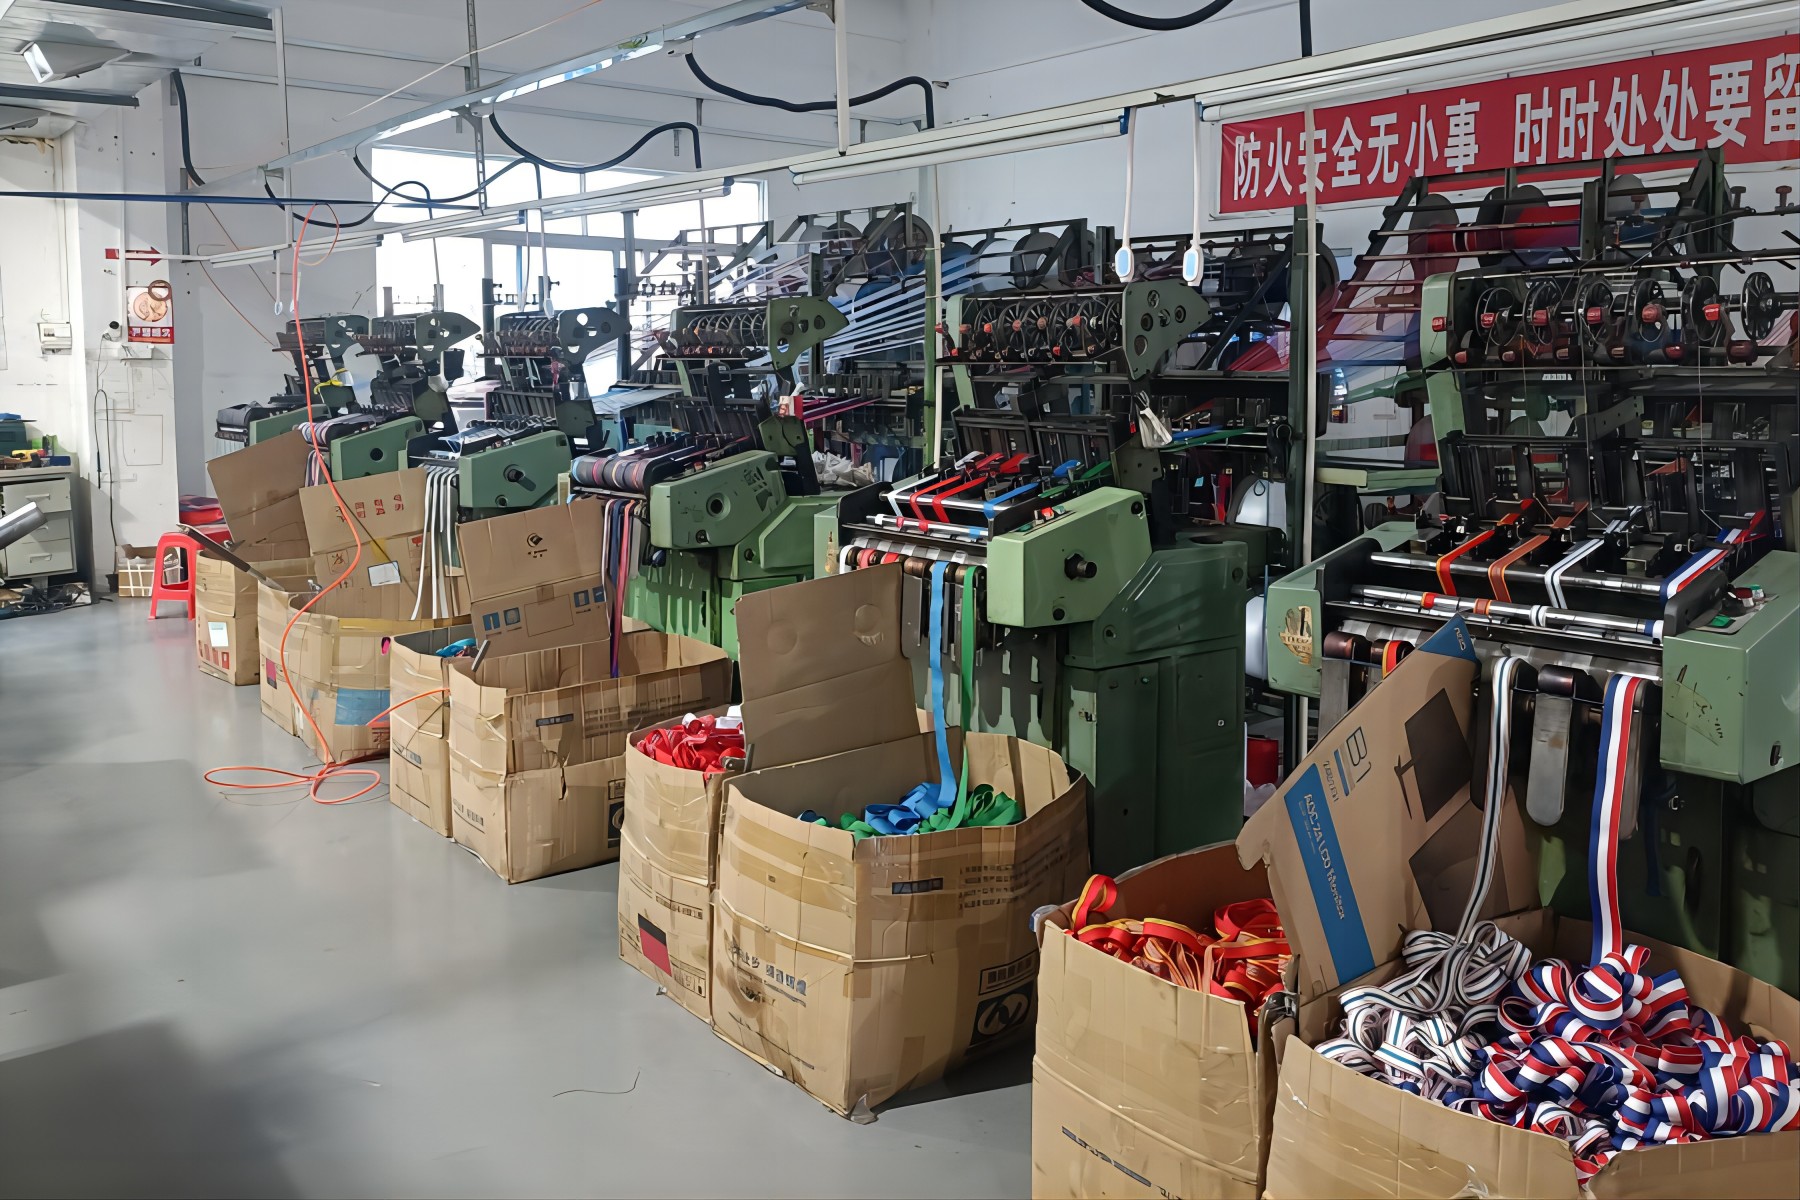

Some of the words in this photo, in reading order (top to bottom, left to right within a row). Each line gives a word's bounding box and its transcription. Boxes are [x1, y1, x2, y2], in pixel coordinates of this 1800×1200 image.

[1233, 98, 1481, 201] 防火安全无小事
[1513, 53, 1800, 165] 时时处处要留
[1346, 726, 1372, 784] B1
